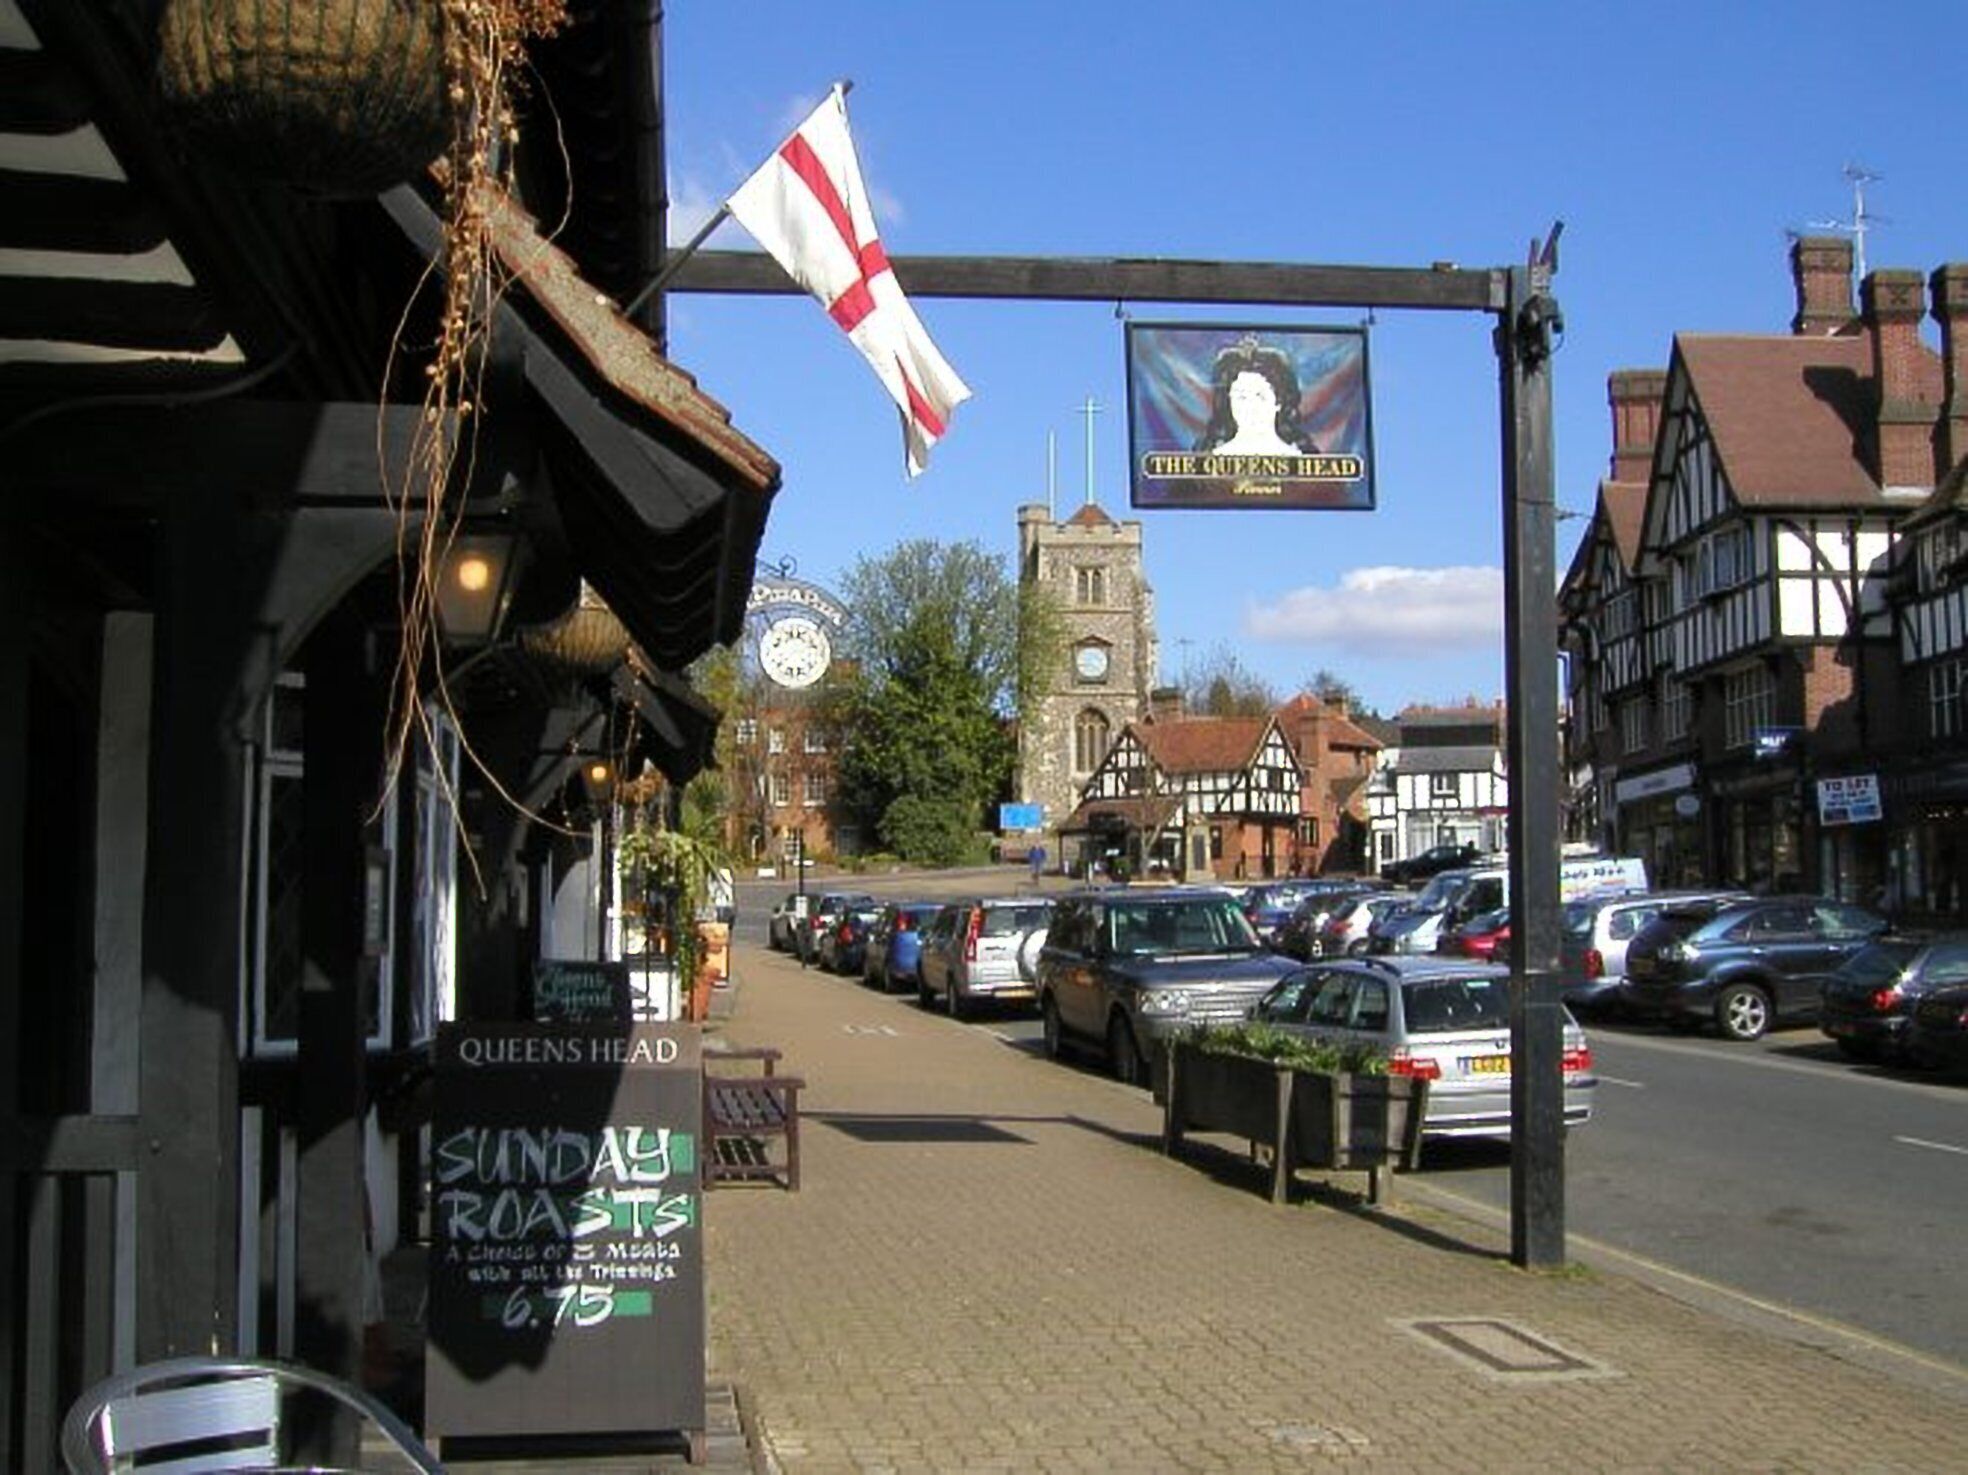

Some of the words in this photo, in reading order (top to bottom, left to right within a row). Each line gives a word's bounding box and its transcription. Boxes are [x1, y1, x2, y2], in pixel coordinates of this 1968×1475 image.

[1152, 455, 1197, 475] THE
[1202, 456, 1290, 479] QUEENS
[1298, 457, 1356, 477] HEAD
[460, 1038, 582, 1066] QUEENS
[592, 1038, 678, 1062] HEAD
[437, 1126, 671, 1184] SUNDAY
[438, 1187, 690, 1239] ROASTS
[607, 1242, 681, 1259] Meats
[503, 1284, 614, 1328] 6.75
